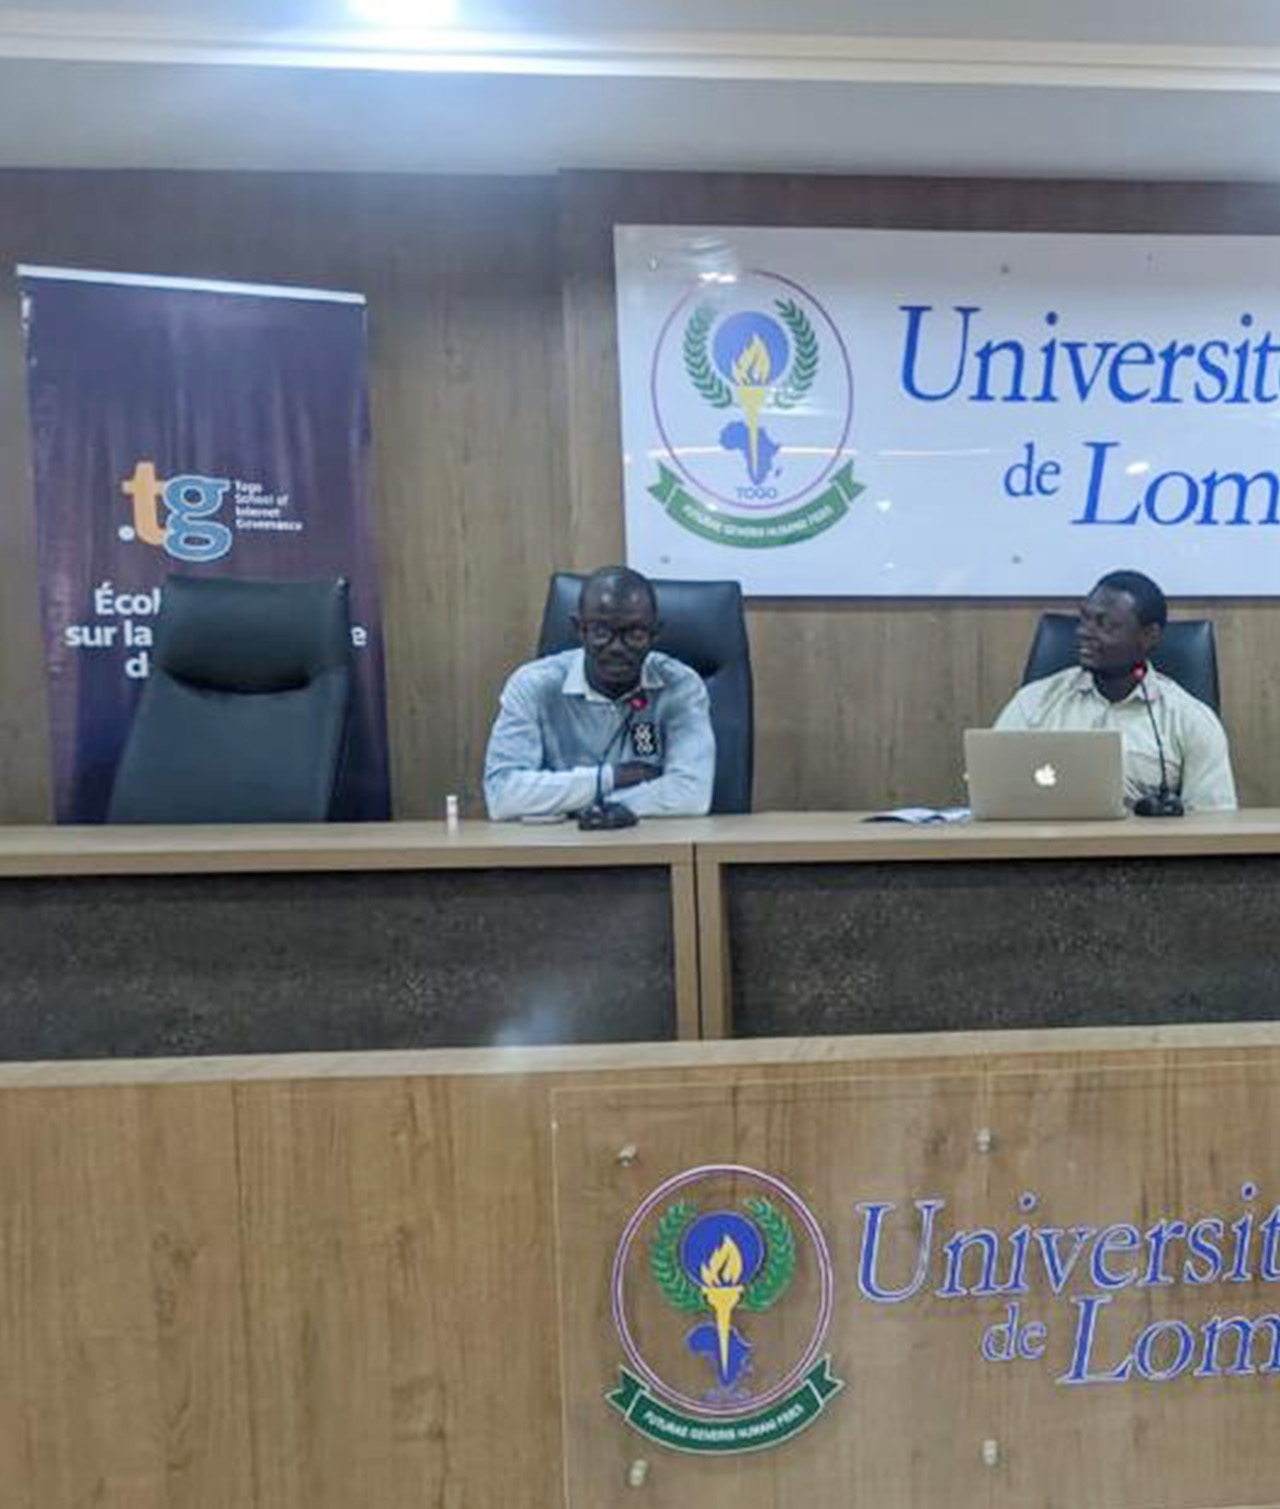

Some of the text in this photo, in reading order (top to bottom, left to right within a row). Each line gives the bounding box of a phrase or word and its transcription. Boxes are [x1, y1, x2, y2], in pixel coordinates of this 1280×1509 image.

[1003, 443, 1062, 498] de
[736, 486, 778, 498] TOGO
[95, 581, 161, 615] Écol
[65, 620, 153, 647] sur la
[981, 1303, 1046, 1362] de
